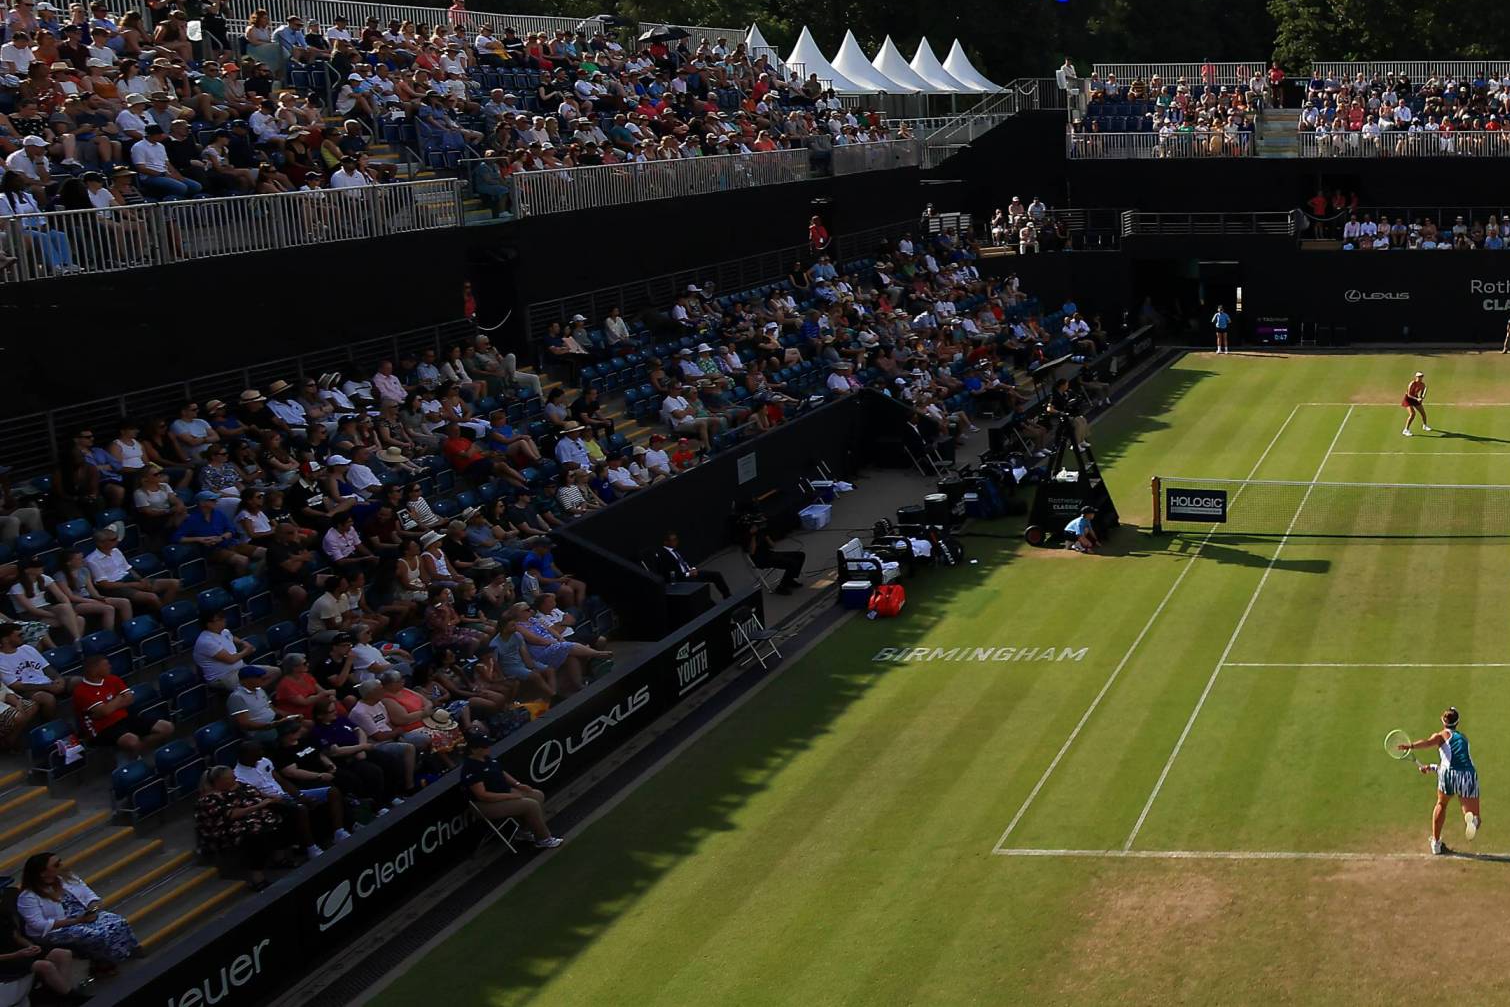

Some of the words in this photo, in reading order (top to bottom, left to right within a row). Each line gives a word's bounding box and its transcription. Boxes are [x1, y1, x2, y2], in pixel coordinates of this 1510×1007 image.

[1362, 292, 1411, 300] LEXUS
[1170, 496, 1223, 508] HOLOGIC
[676, 648, 709, 687] YOUTH
[872, 647, 1089, 662] BIRMINGHAM
[565, 684, 651, 755] LEXUS
[356, 843, 418, 898] Clear
[167, 938, 271, 1007] euer
